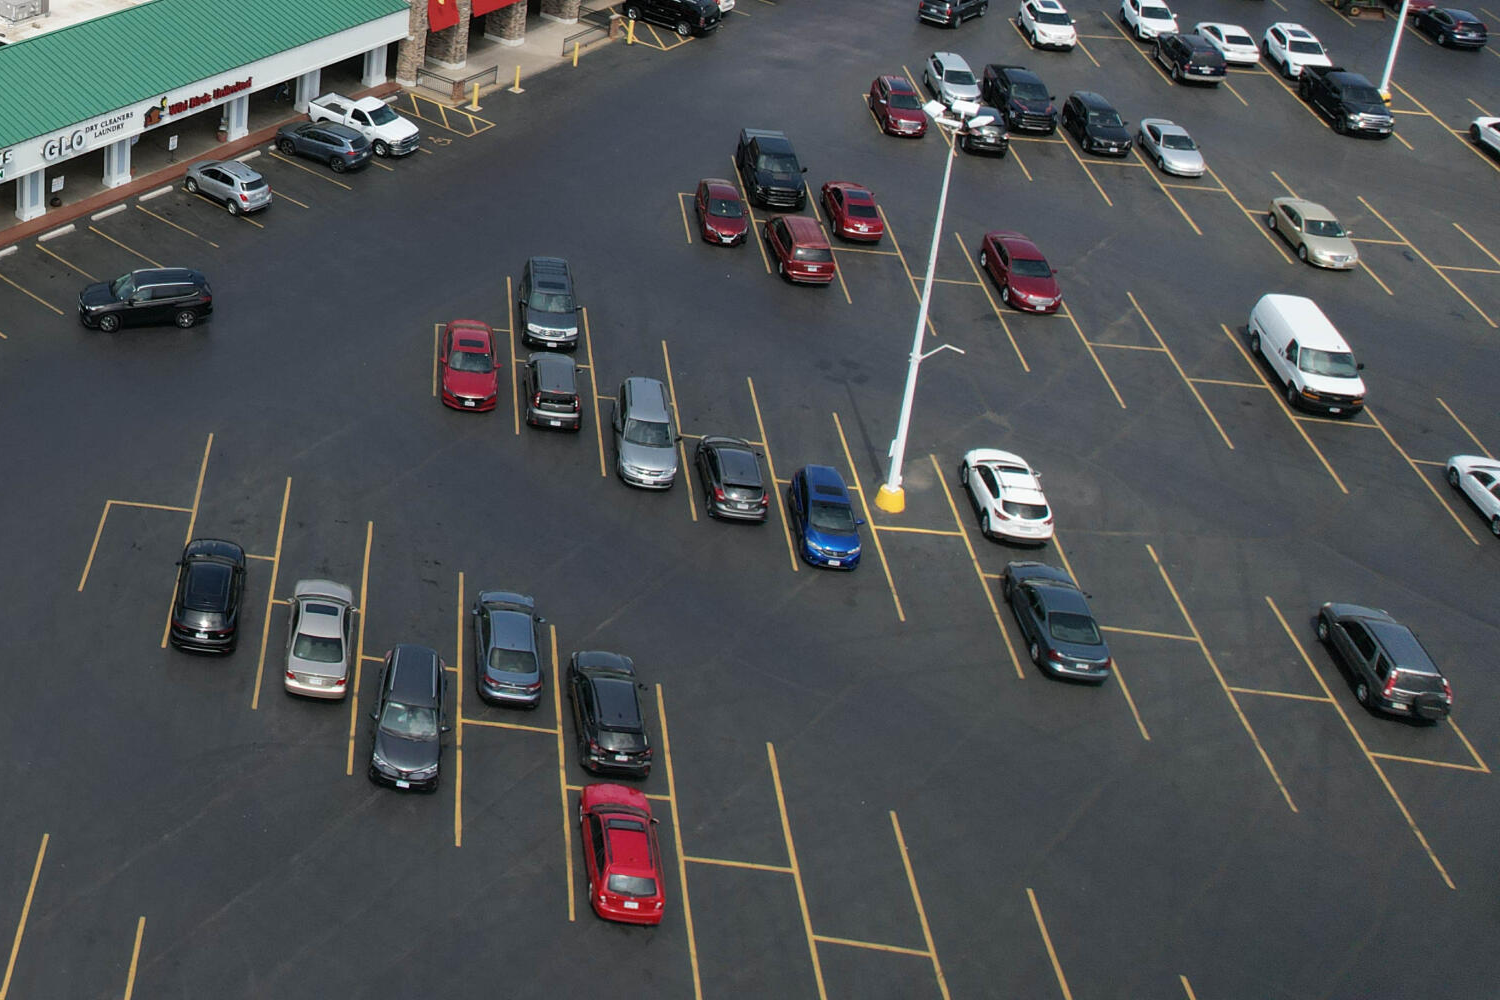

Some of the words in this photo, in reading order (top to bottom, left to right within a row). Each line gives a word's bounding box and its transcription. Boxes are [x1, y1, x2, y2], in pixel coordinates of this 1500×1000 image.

[169, 100, 188, 116] Wild
[189, 93, 212, 109] Birds
[213, 77, 253, 100] Unlimited
[85, 124, 99, 134] DRY
[100, 112, 134, 128] CLEANERS
[94, 123, 125, 138] LAUNDRY
[44, 130, 85, 161] GLO
